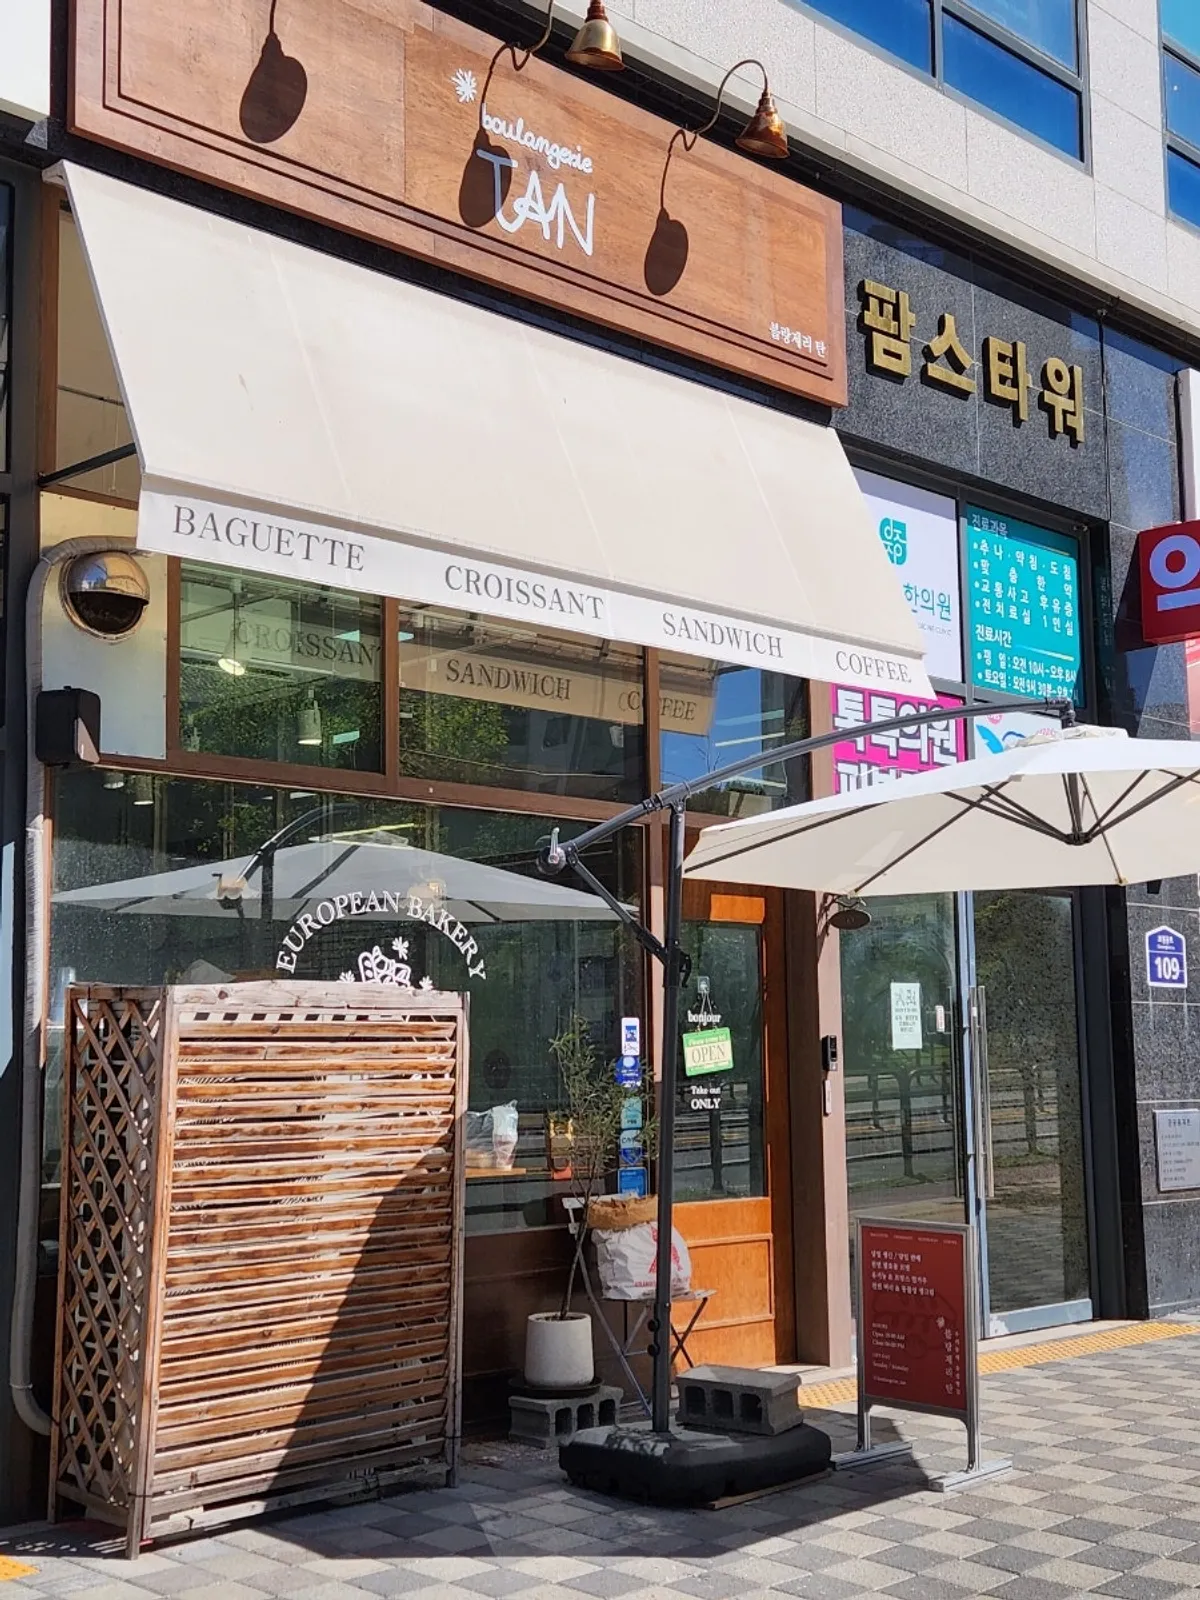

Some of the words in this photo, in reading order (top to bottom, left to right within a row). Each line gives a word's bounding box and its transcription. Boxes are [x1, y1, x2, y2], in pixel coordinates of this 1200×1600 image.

[480, 103, 593, 173] boulangerie
[476, 149, 595, 256] TAN
[815, 340, 827, 358] 탄
[861, 279, 1085, 443] 팜스타워
[172, 504, 366, 573] BAGUETTE
[972, 513, 1008, 540] 진료과목
[444, 564, 605, 620] CROISSANT
[237, 620, 381, 666] CROISSAN
[662, 612, 785, 659] SANDWICH
[975, 624, 1012, 648] 진료시간
[446, 659, 571, 700] SANDWICH
[835, 650, 913, 684] COFFEE
[276, 890, 401, 974] EUROPEAN
[406, 894, 486, 980] BAKERY
[1154, 956, 1180, 980] 109
[687, 1010, 722, 1026] bonjour
[691, 1044, 726, 1064] OPEN
[690, 1085, 708, 1095] Take
[690, 1097, 721, 1110] ONLY
